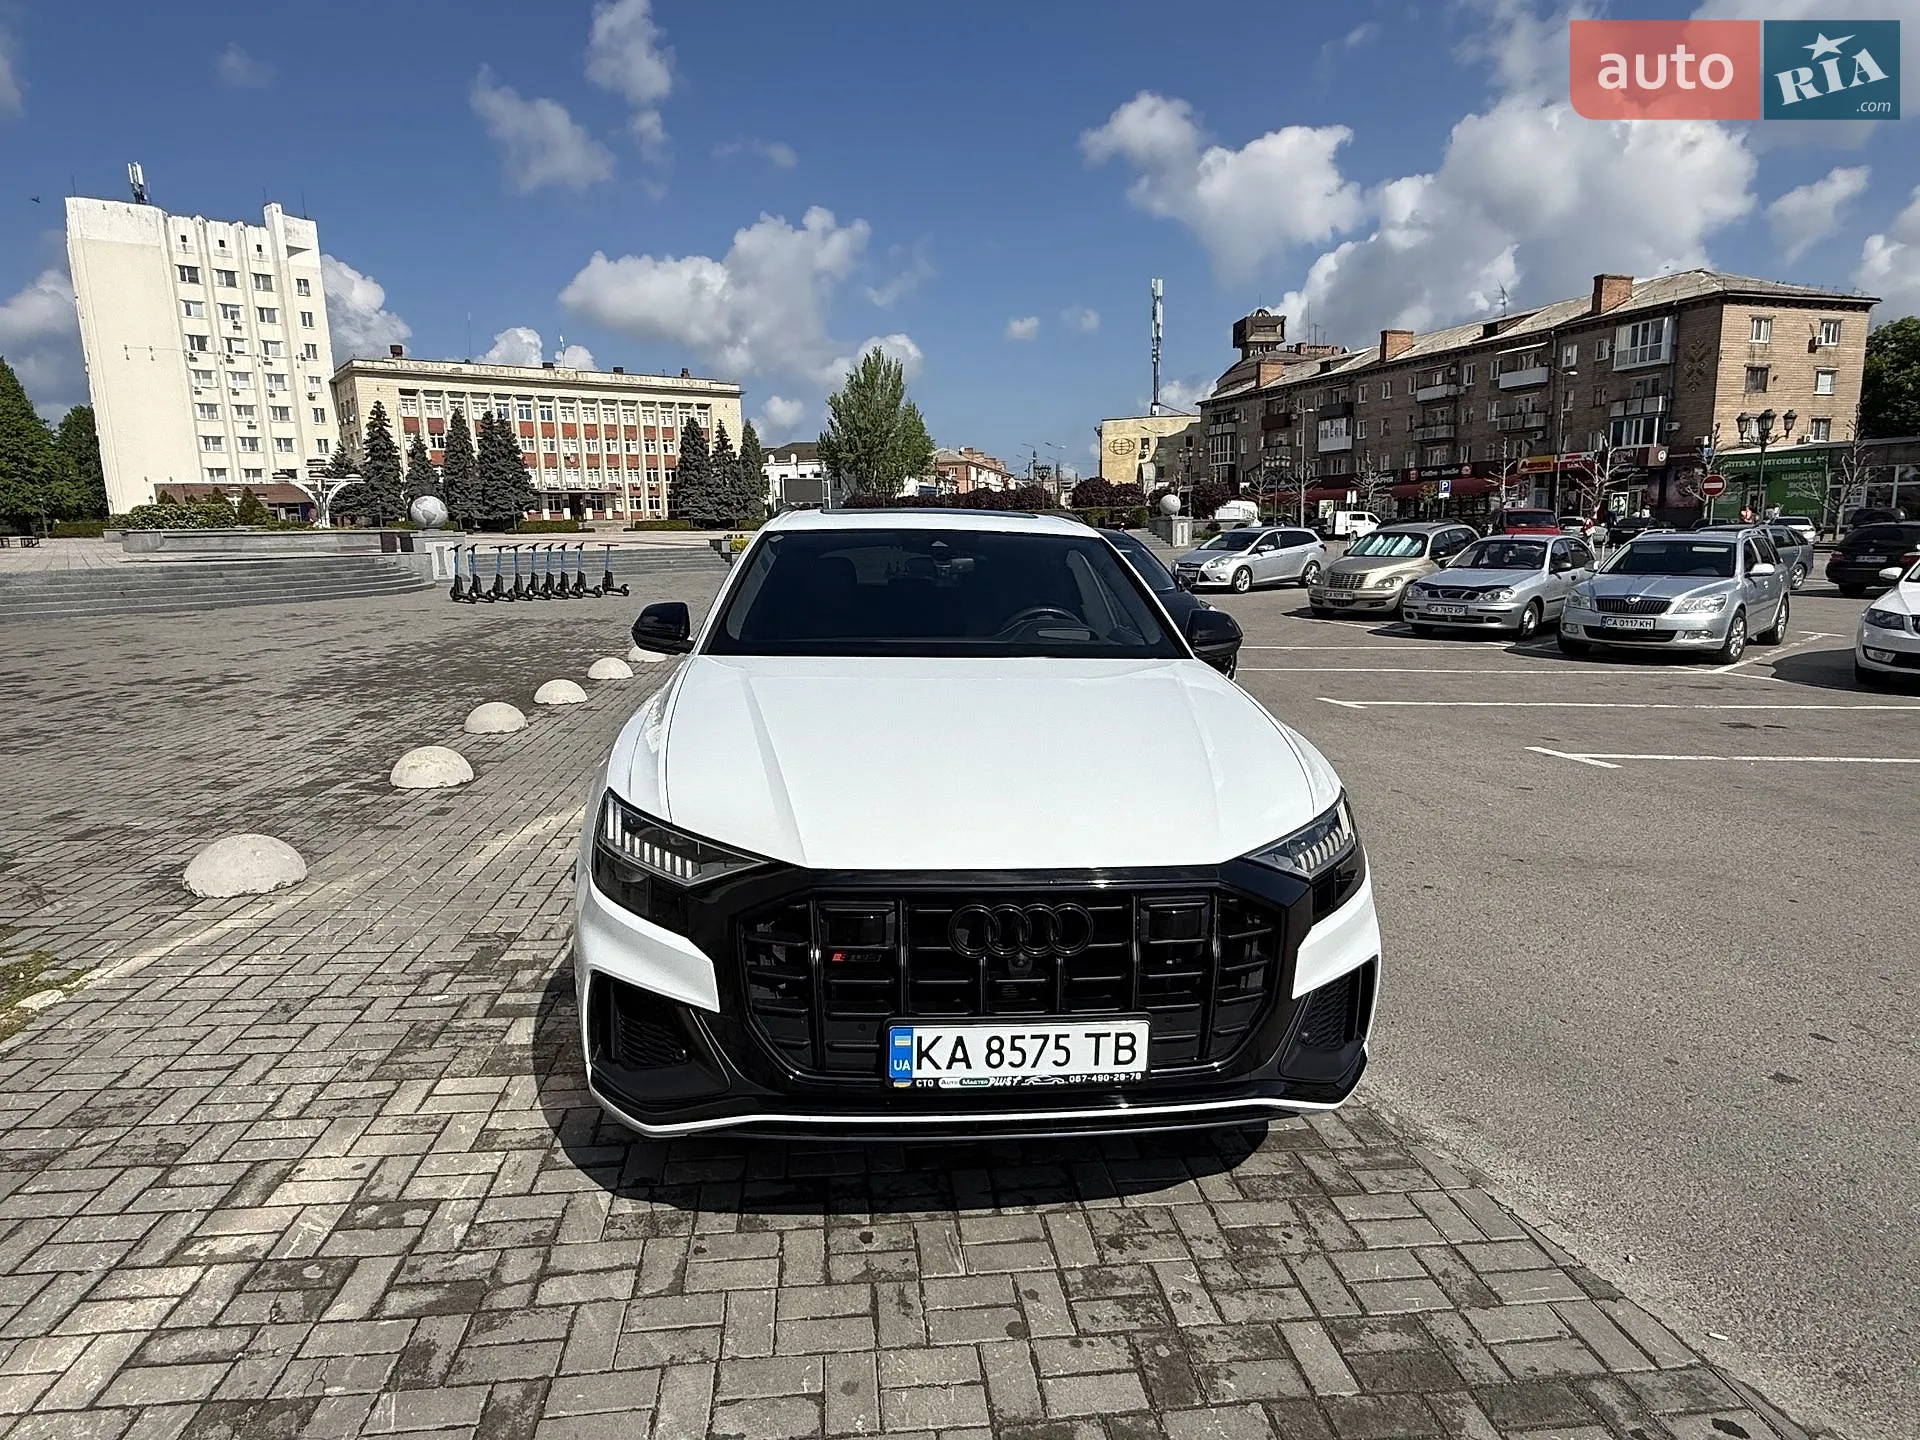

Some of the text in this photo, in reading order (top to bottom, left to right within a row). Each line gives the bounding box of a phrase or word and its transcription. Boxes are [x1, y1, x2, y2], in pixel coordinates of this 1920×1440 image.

[1441, 481, 1449, 490] P
[1606, 618, 1652, 628] CA 0117 KH
[916, 1032, 1137, 1071] KA 8575 TB
[893, 1059, 911, 1071] UA
